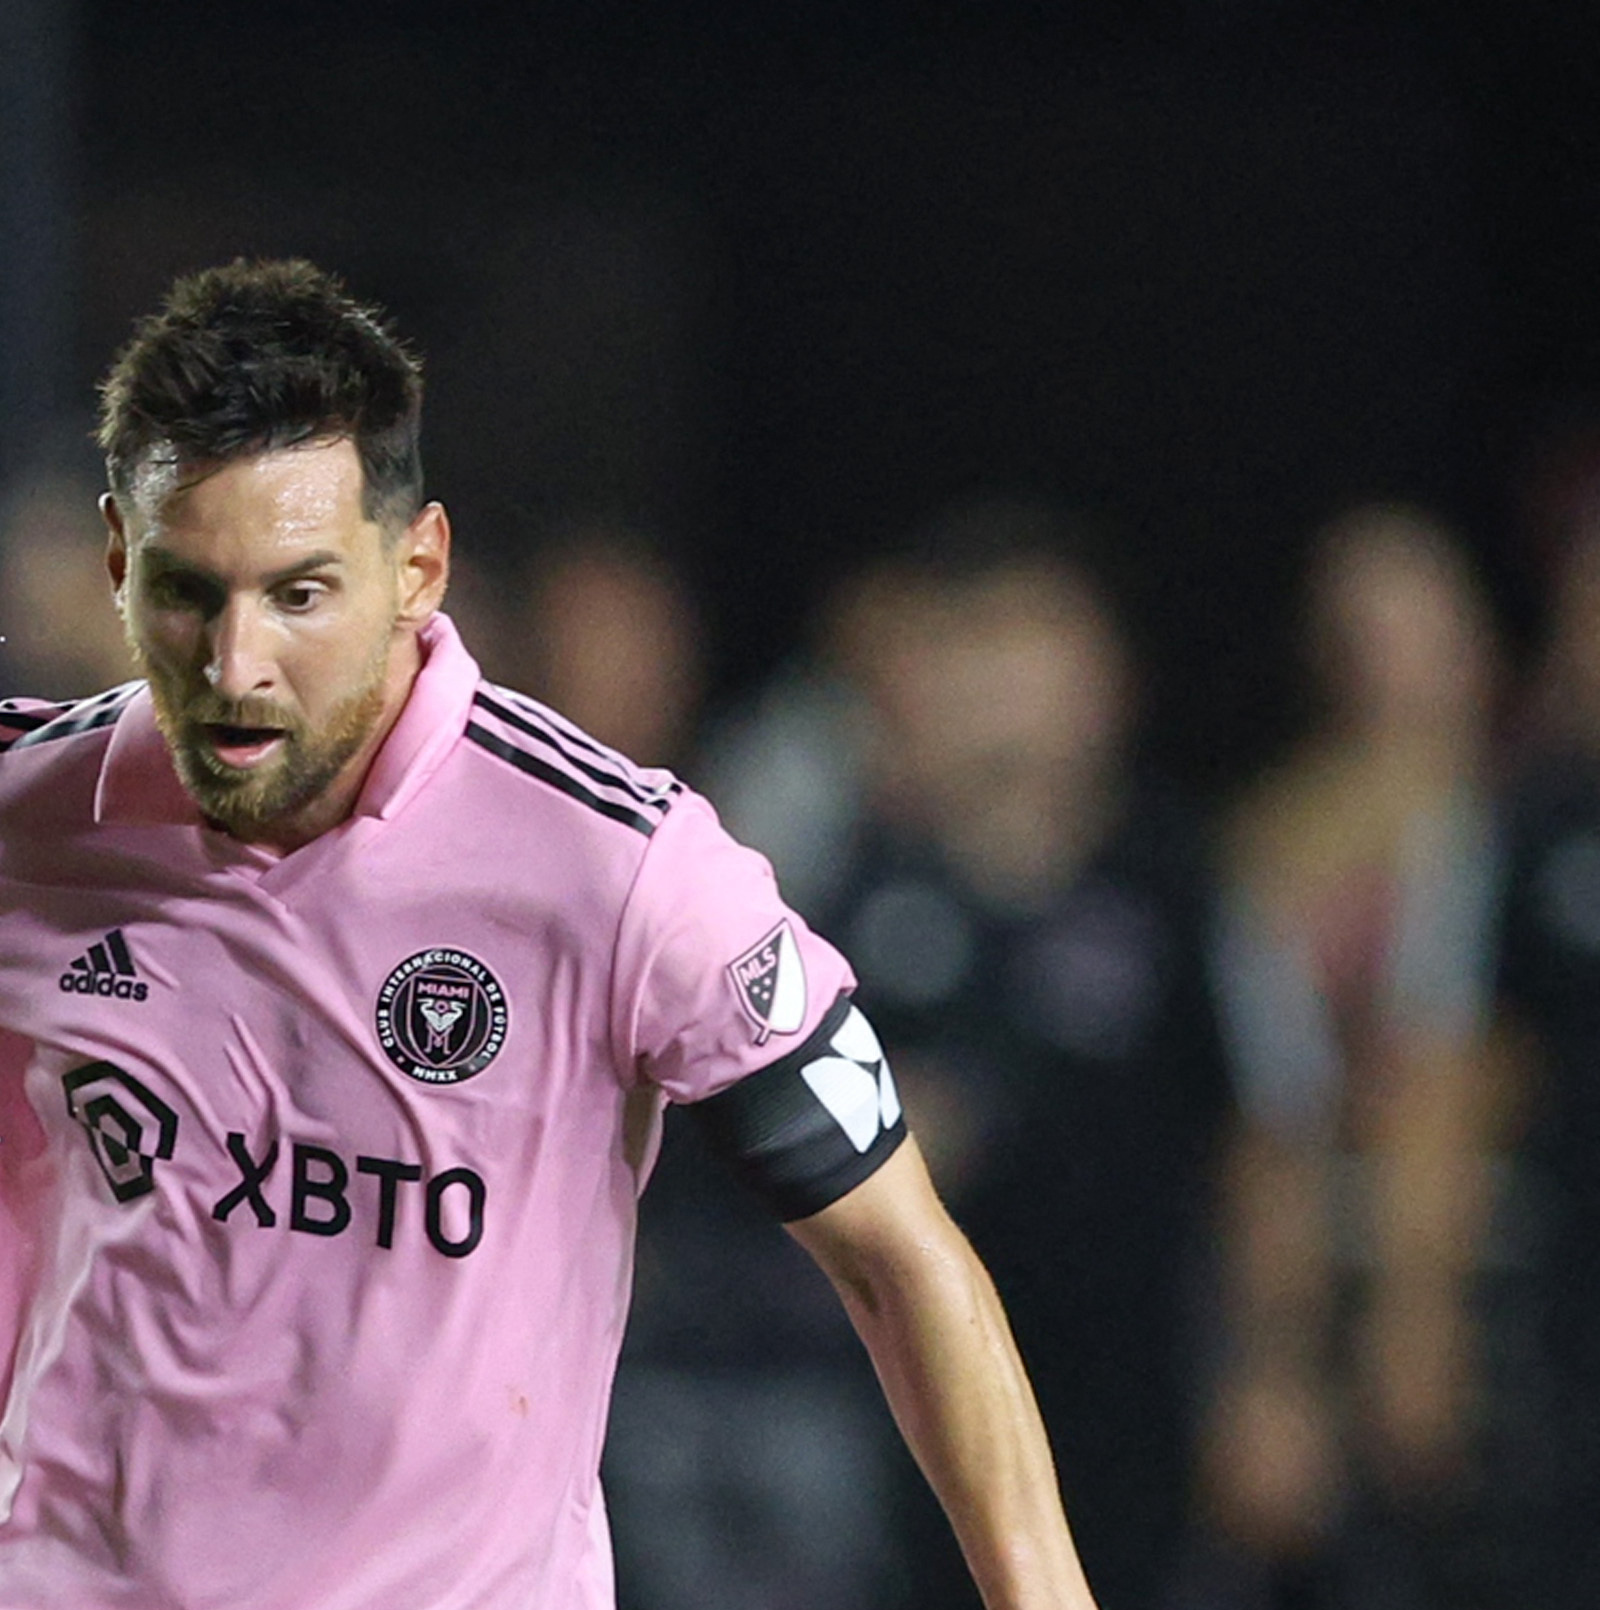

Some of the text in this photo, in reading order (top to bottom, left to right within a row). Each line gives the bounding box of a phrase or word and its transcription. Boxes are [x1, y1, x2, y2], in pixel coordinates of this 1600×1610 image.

[381, 951, 487, 1003] INTERNACIONAL
[739, 945, 776, 987] MLS
[60, 970, 149, 1002] adidas
[416, 982, 470, 999] MIAMI
[485, 982, 502, 1002] DE
[378, 1008, 394, 1049] CLUB
[411, 1066, 458, 1081] MMXX
[212, 1131, 486, 1258] XBTO
